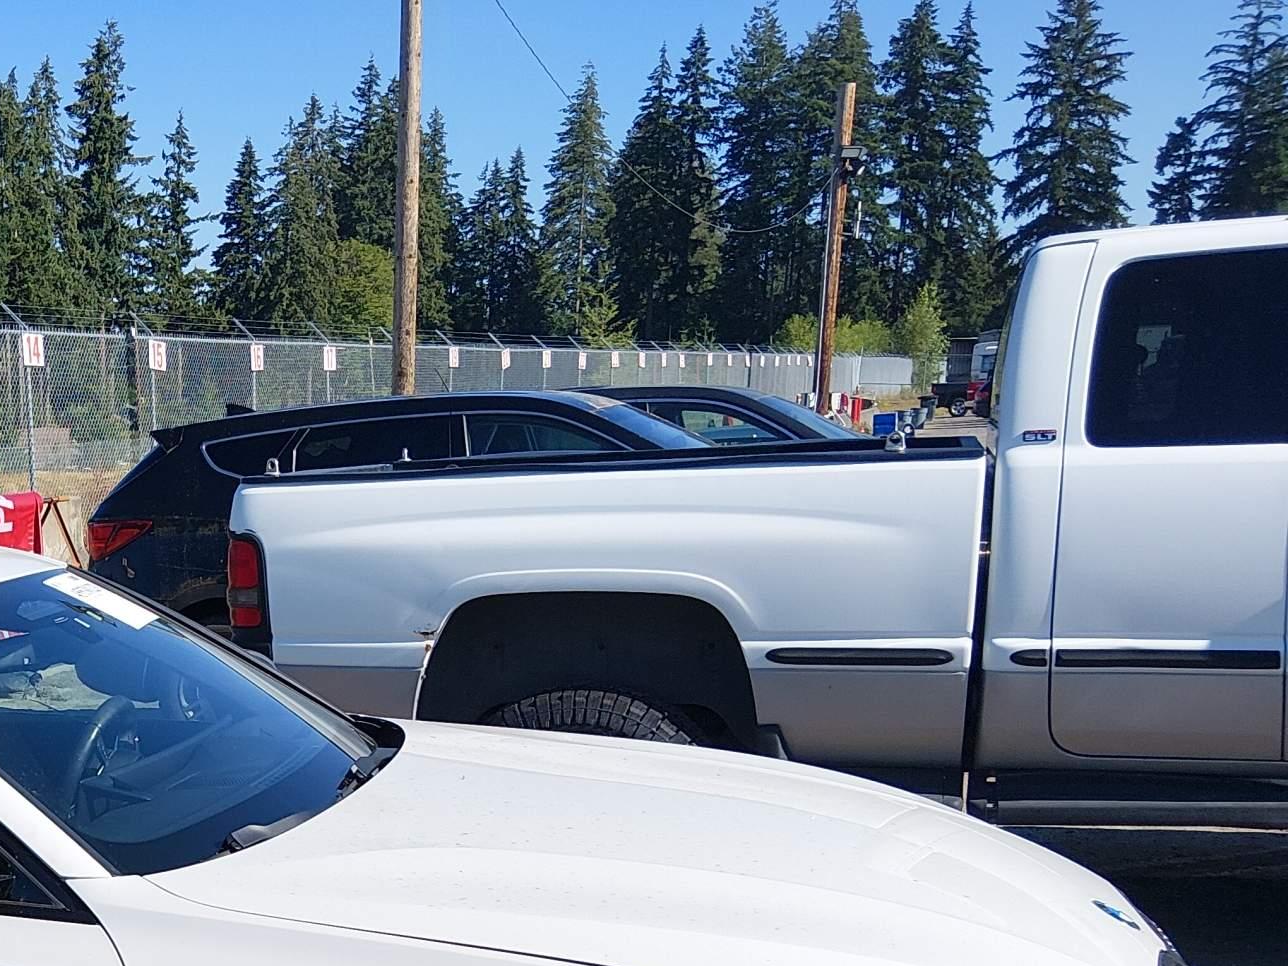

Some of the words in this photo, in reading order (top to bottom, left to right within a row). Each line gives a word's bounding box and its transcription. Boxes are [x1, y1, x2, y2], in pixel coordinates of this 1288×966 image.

[26, 335, 41, 364] 14
[152, 342, 163, 369] 15
[1024, 432, 1056, 441] SLT
